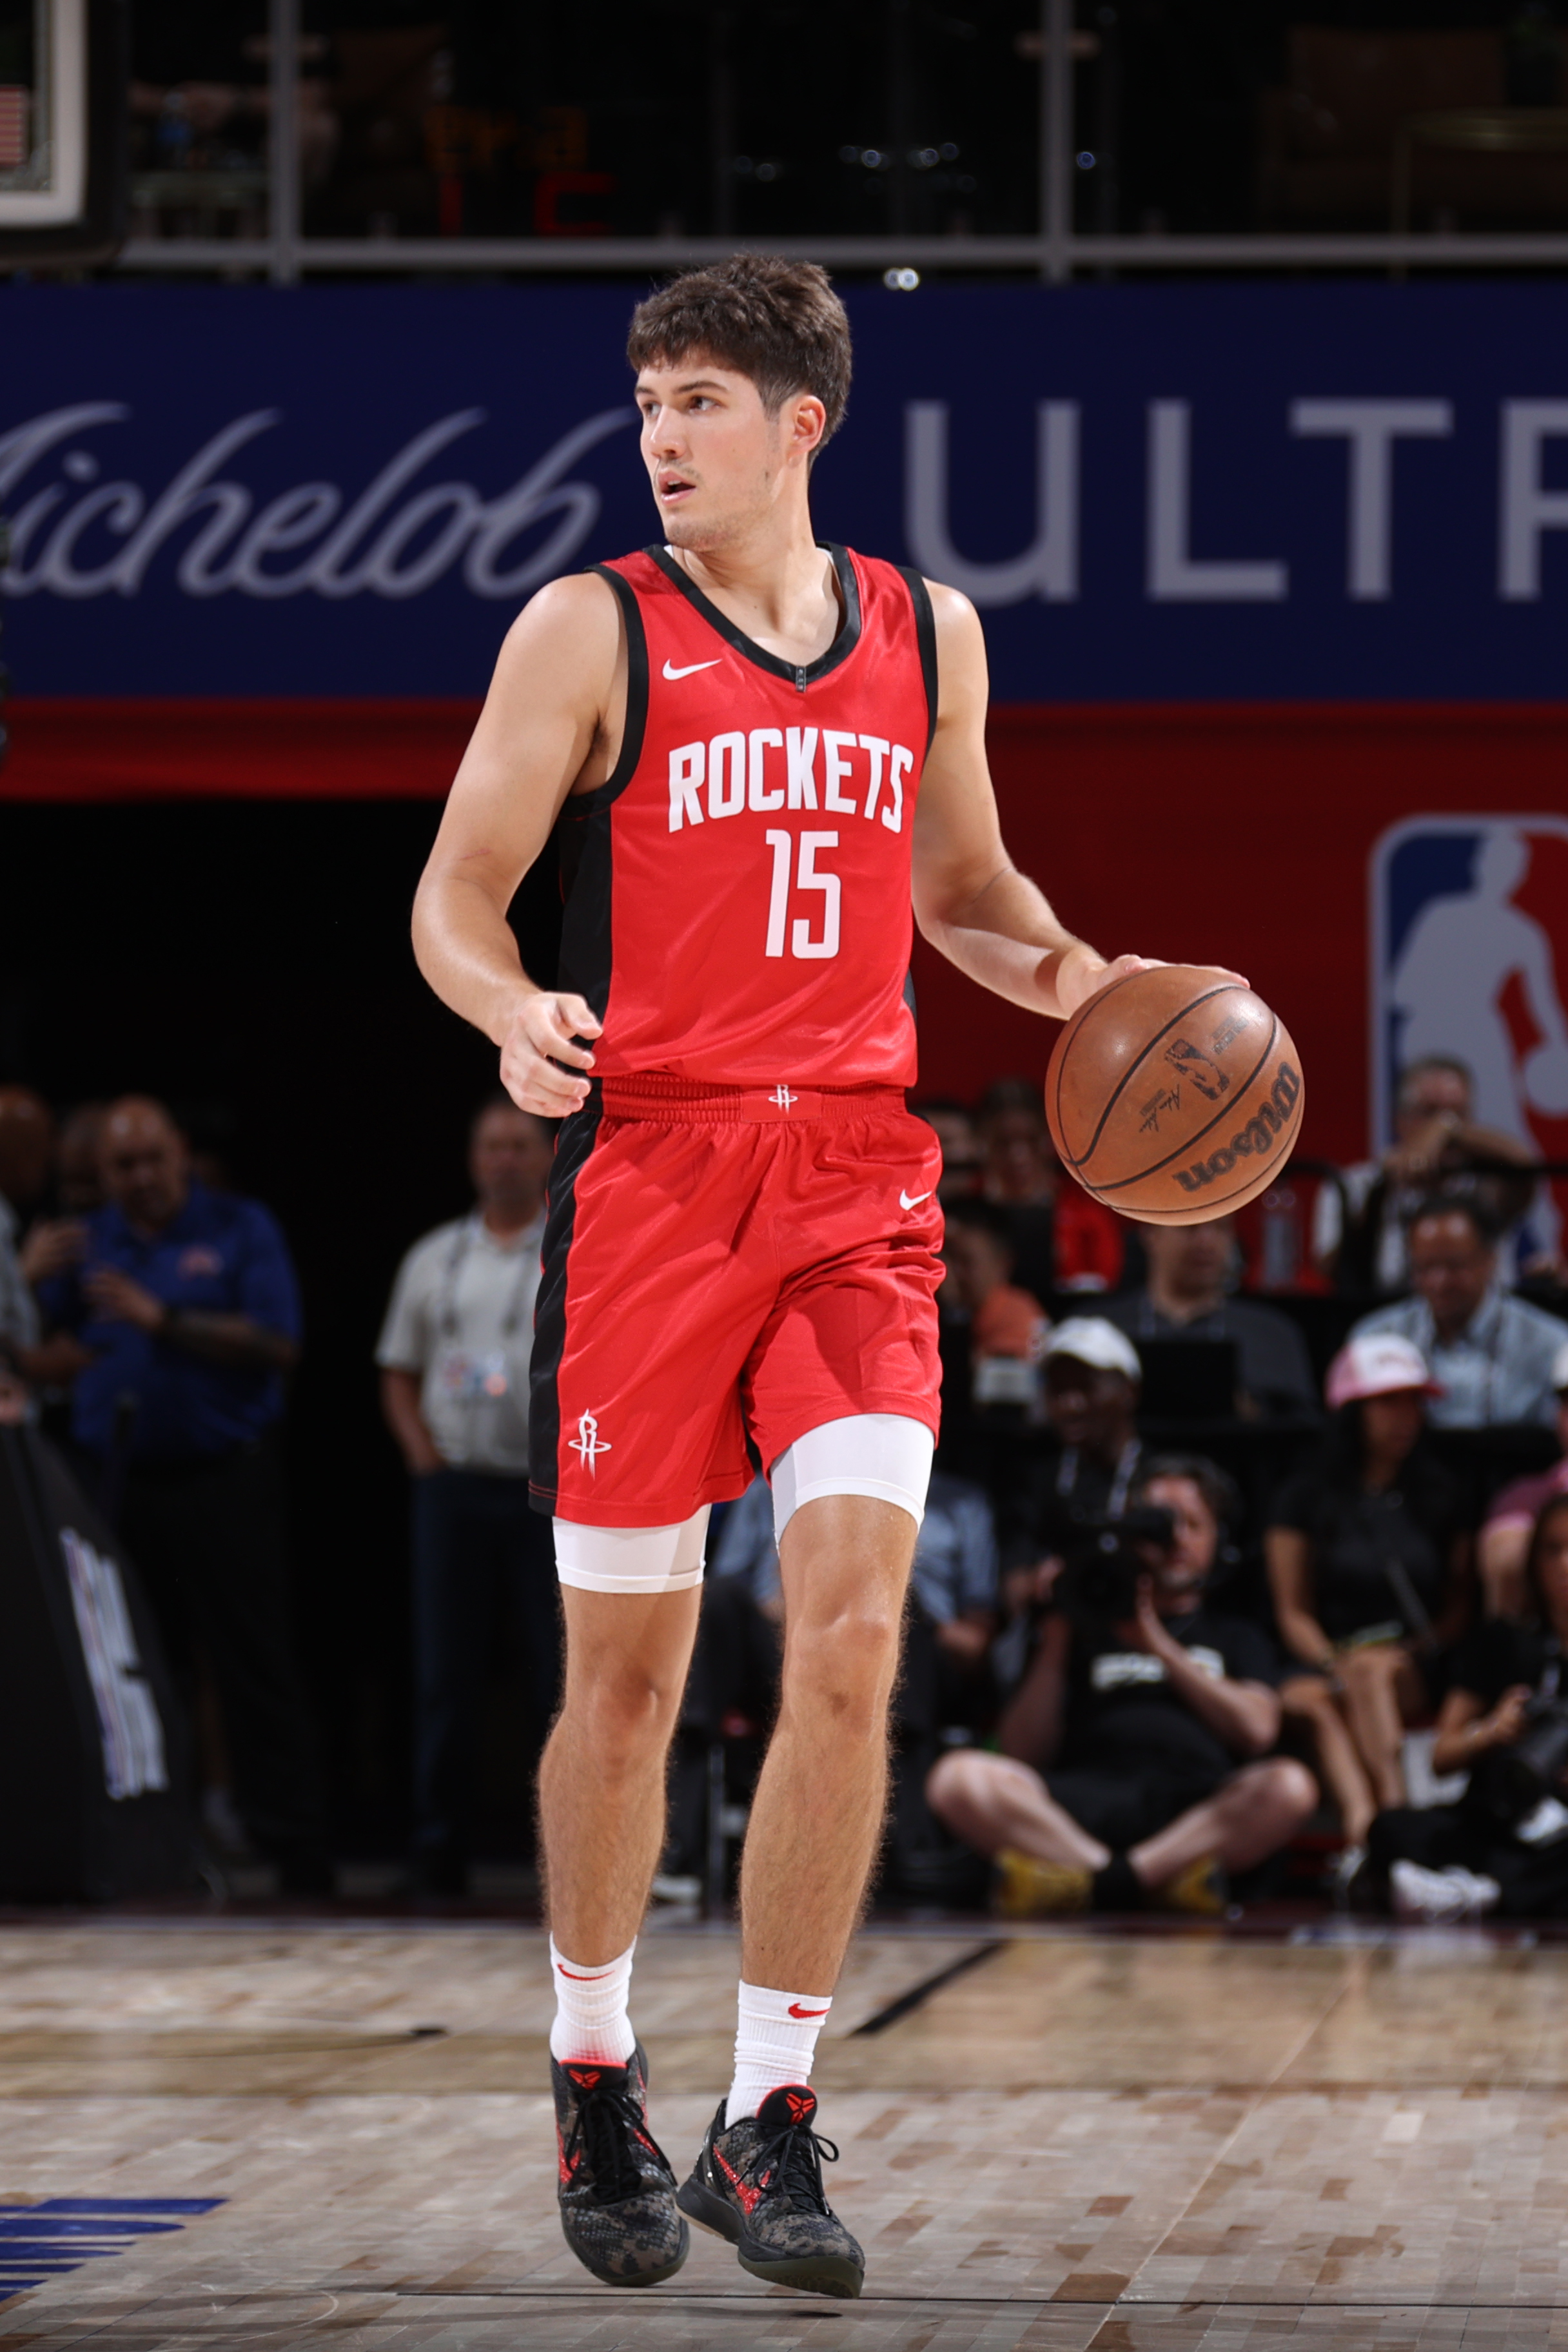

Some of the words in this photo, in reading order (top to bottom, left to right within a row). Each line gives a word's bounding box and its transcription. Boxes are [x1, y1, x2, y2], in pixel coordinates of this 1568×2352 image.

[669, 726, 914, 833] ROCKETS
[765, 829, 841, 959] 15
[1172, 1061, 1300, 1193] Wilson
